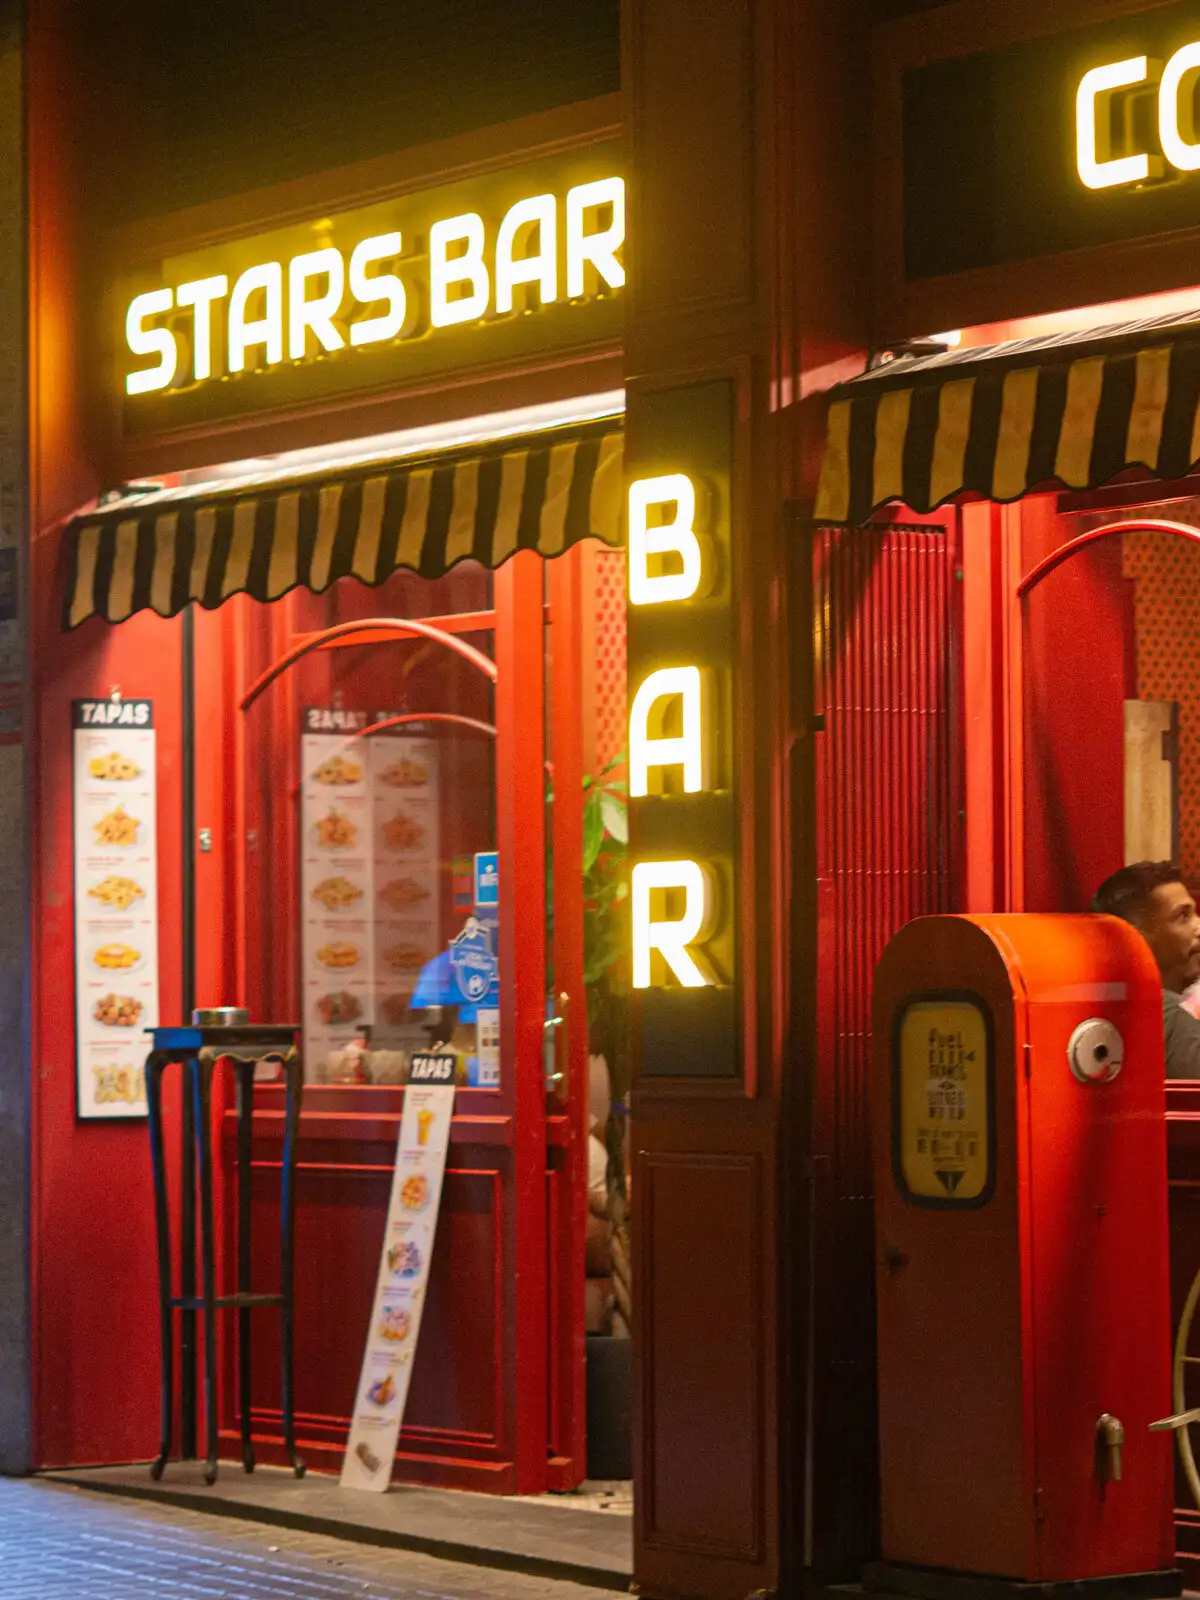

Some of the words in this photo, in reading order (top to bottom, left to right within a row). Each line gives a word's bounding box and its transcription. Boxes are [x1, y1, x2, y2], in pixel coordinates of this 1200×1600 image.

[126, 232, 407, 395] STARS
[429, 176, 625, 328] BAR
[81, 703, 149, 725] TAPAS
[628, 473, 707, 990] BAR
[411, 1058, 453, 1080] TAPAS
